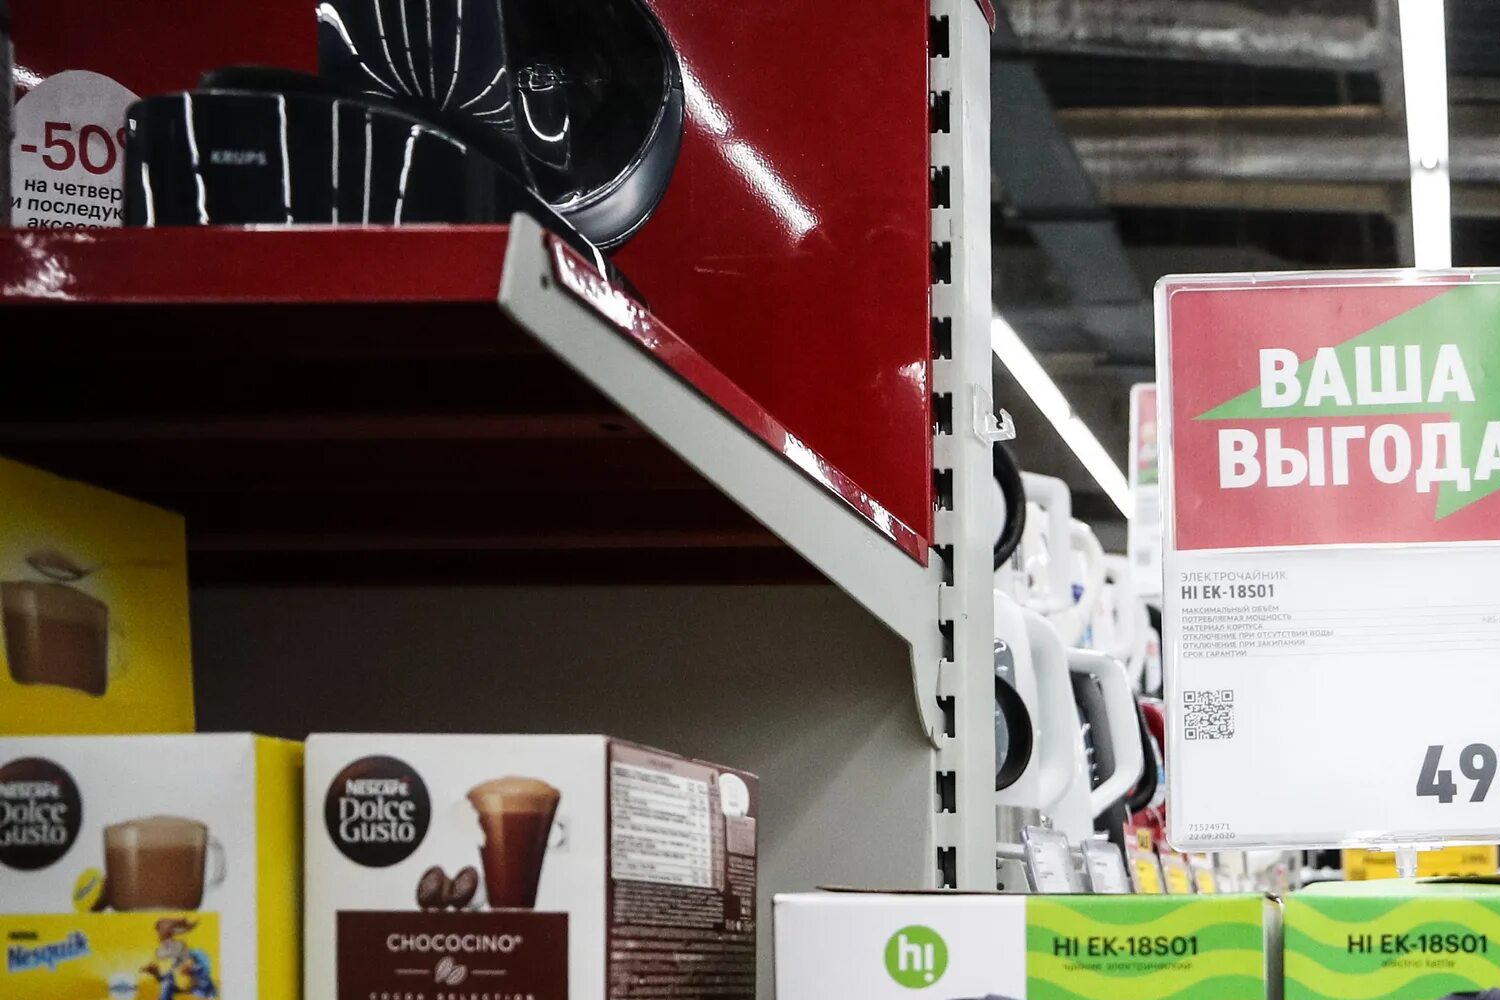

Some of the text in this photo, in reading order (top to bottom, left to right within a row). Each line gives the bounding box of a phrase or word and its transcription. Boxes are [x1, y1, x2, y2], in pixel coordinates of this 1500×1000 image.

[210, 151, 268, 166] KRUPS
[25, 179, 47, 193] на
[1258, 344, 1476, 408] ВАША
[1180, 570, 1287, 582] ЭЛЕКТРОЧАЙНИК
[1181, 584, 1274, 599] HI EK-18S01
[1182, 606, 1250, 615] МАКСИМАЛЬНЫЙ
[1182, 613, 1292, 623] ПОТРЕБЛЯЕМАЯ МОЩНОСТЬ
[1182, 623, 1263, 632] МАТЕРИАЛ КОРПУСА
[1183, 632, 1237, 641] ОТКЛЮЧЕНИЕ
[1239, 632, 1255, 640] ПРИ
[1257, 631, 1308, 639] ОТСУТСТВИИ
[1183, 641, 1237, 650] ОТКЛЮЧЕНИЕ
[1258, 639, 1306, 647] ЗАКИПАНИИ
[1183, 650, 1247, 659] СРОК ГАРАНТИИ
[339, 797, 416, 822] Dolce
[339, 819, 416, 843] Gusto
[1189, 823, 1230, 831] 71524971
[1189, 832, 1236, 840] 22.09.2020
[1053, 935, 1198, 956] HI EK-18S01
[1347, 934, 1489, 954] HI EK-18S01
